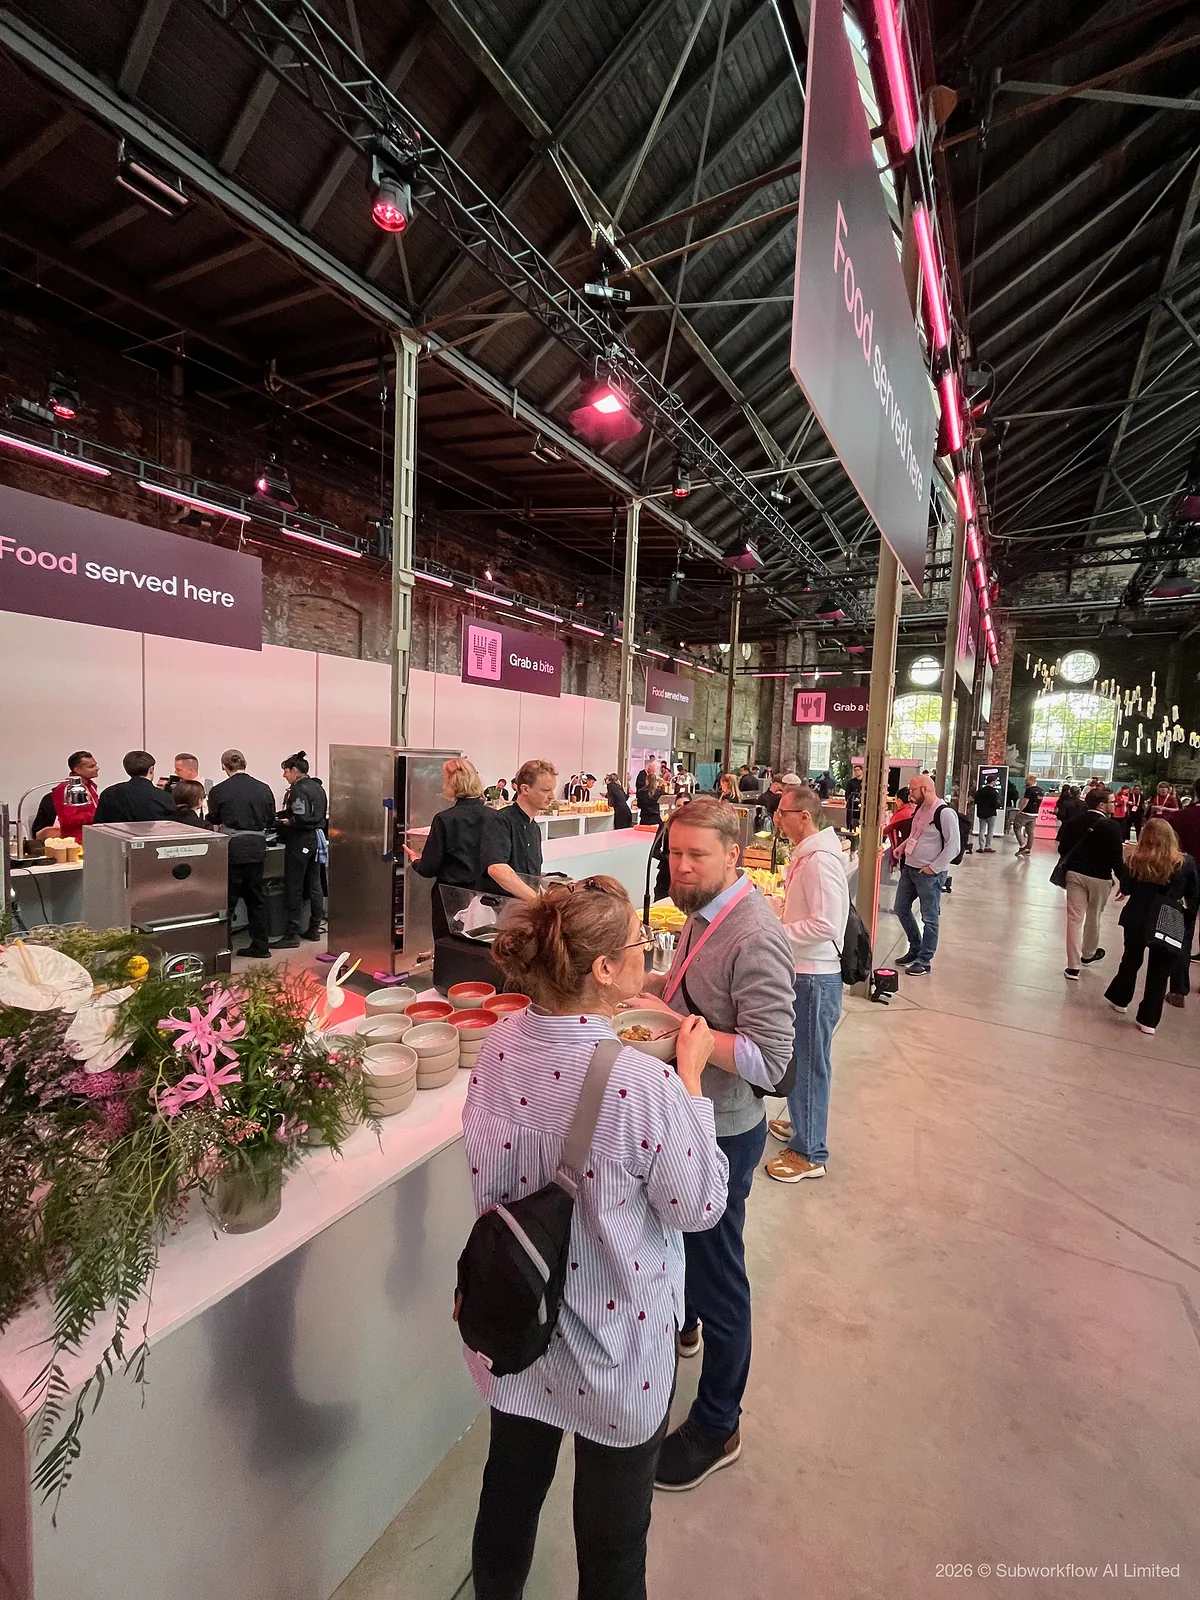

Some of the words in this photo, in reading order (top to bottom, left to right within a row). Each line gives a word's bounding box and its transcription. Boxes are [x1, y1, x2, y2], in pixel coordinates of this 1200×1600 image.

[834, 200, 874, 367] Food
[873, 344, 908, 461] served
[906, 428, 923, 501] here
[0, 535, 78, 575] Food
[85, 561, 178, 596] served
[183, 578, 235, 608] here
[509, 653, 532, 670] Grab
[532, 661, 538, 671] a
[539, 659, 555, 674] bite
[652, 686, 664, 698] Food
[833, 702, 857, 711] Grab
